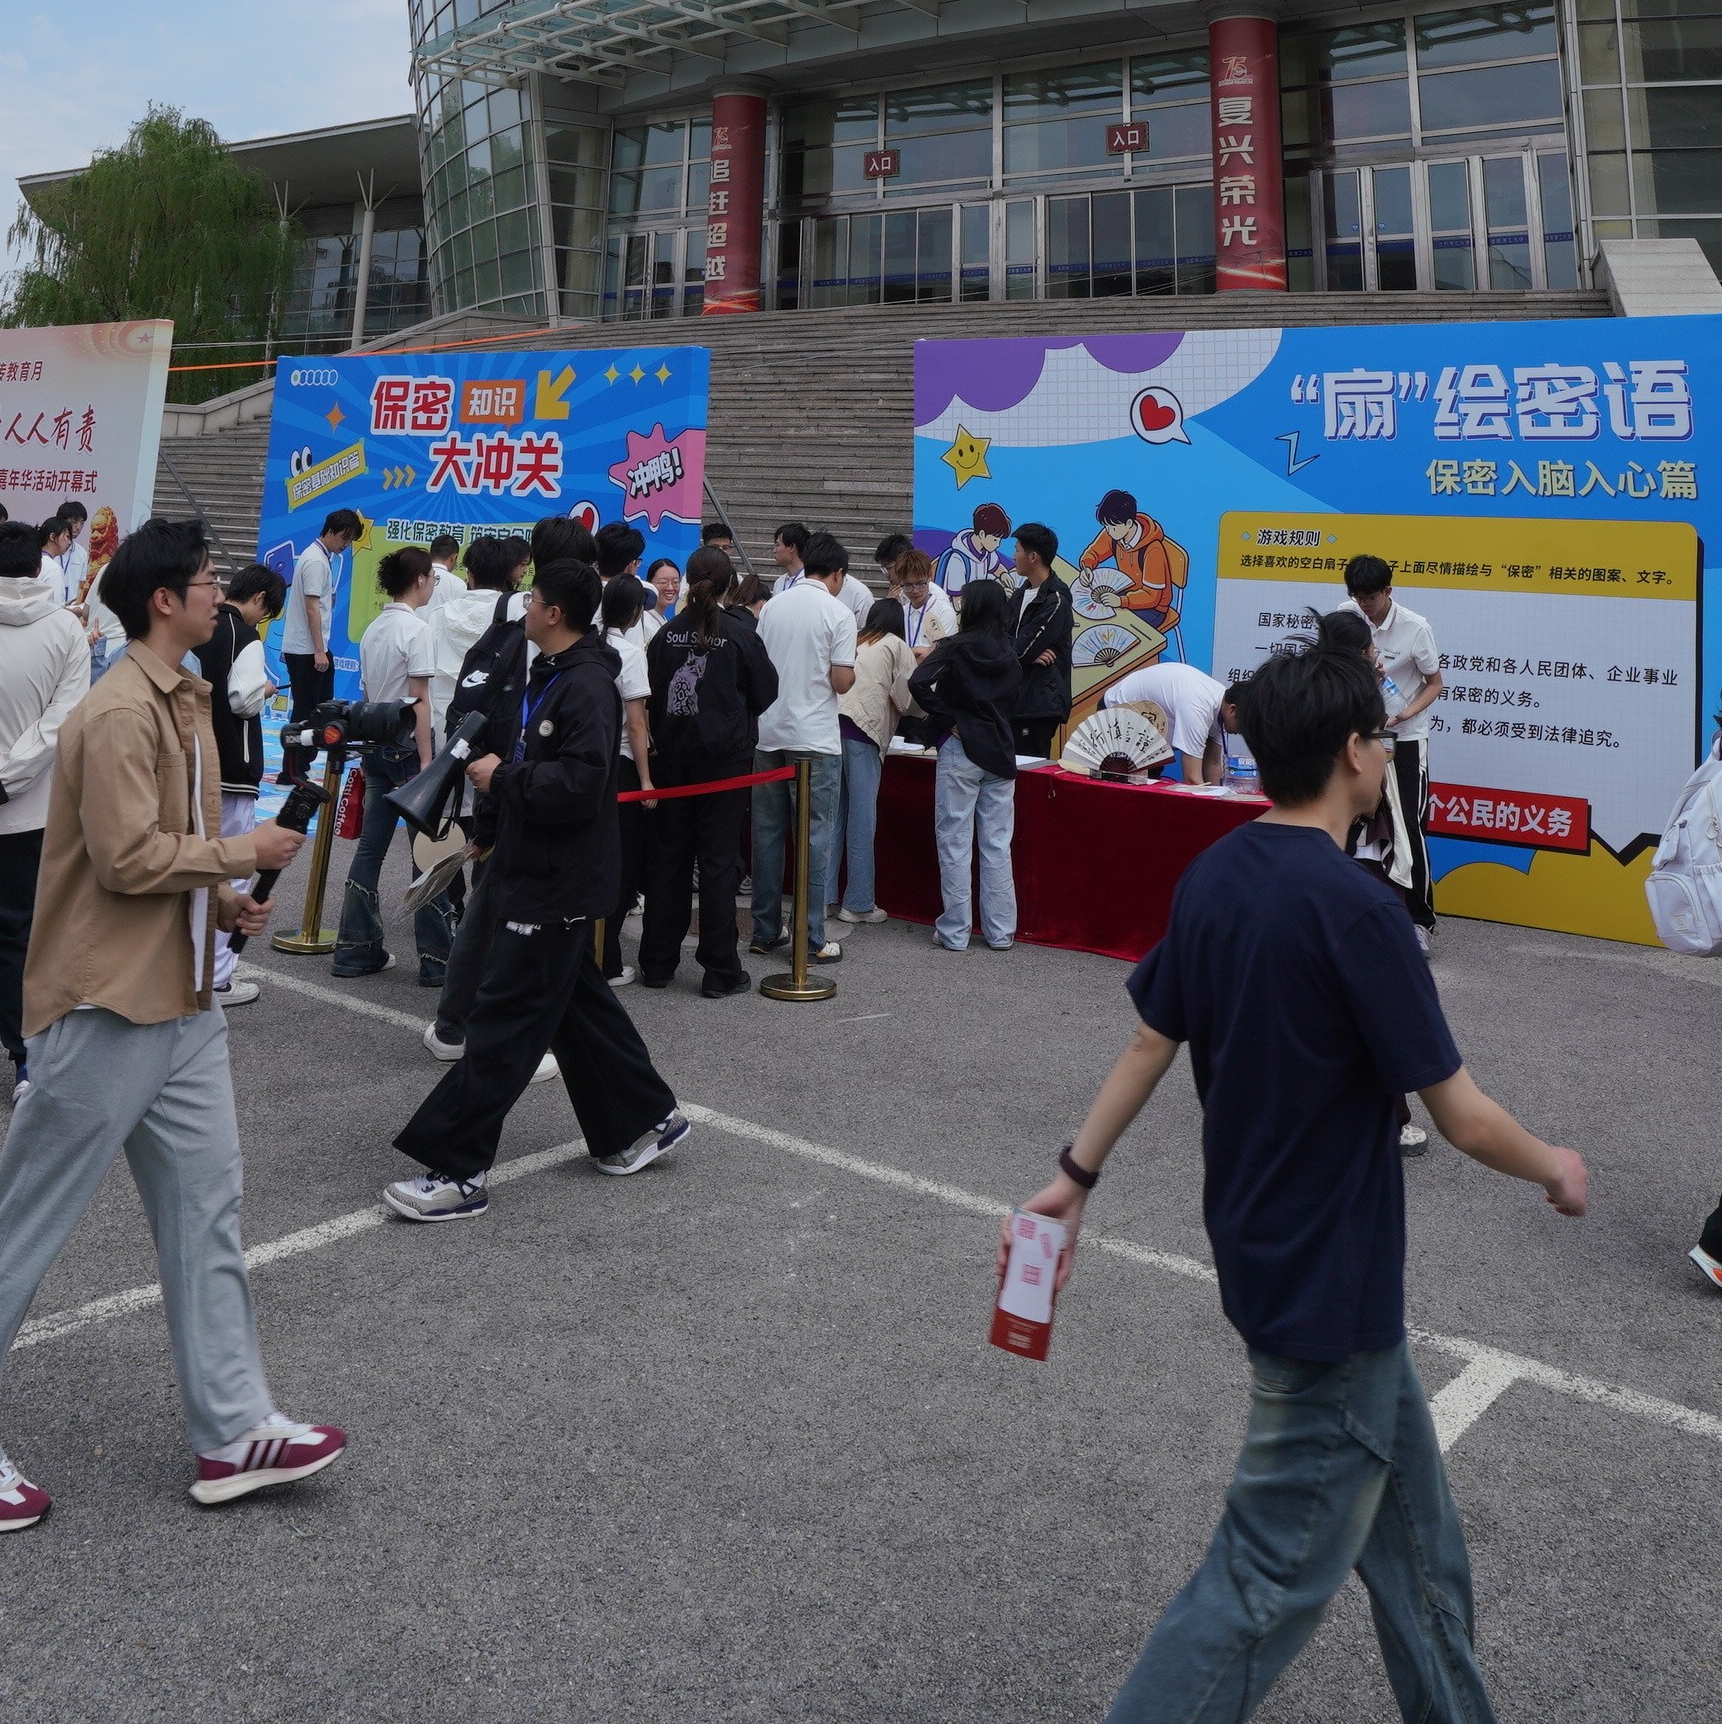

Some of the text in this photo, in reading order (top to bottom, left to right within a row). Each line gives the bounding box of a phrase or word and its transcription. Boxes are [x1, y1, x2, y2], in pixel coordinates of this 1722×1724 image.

[1113, 130, 1140, 147] 入口
[869, 156, 892, 171] 入口
[1218, 96, 1258, 247] 复兴荣光
[706, 159, 730, 281] 追赶超越
[374, 380, 517, 431] 保密 知识
[1290, 359, 1695, 442] “扇”绘密语
[430, 436, 560, 493] 大冲关
[1425, 459, 1698, 500] 保密入脑入心篇
[1256, 528, 1321, 547] 游戏规则
[666, 631, 728, 648] Soul Svior
[1258, 612, 1322, 630] 国家秘密
[1438, 652, 1679, 687] 各政党和各人民团体、企业事业
[1430, 716, 1624, 749] 为，都必须受到法律追究。
[1428, 793, 1573, 838] 个公民的义务
